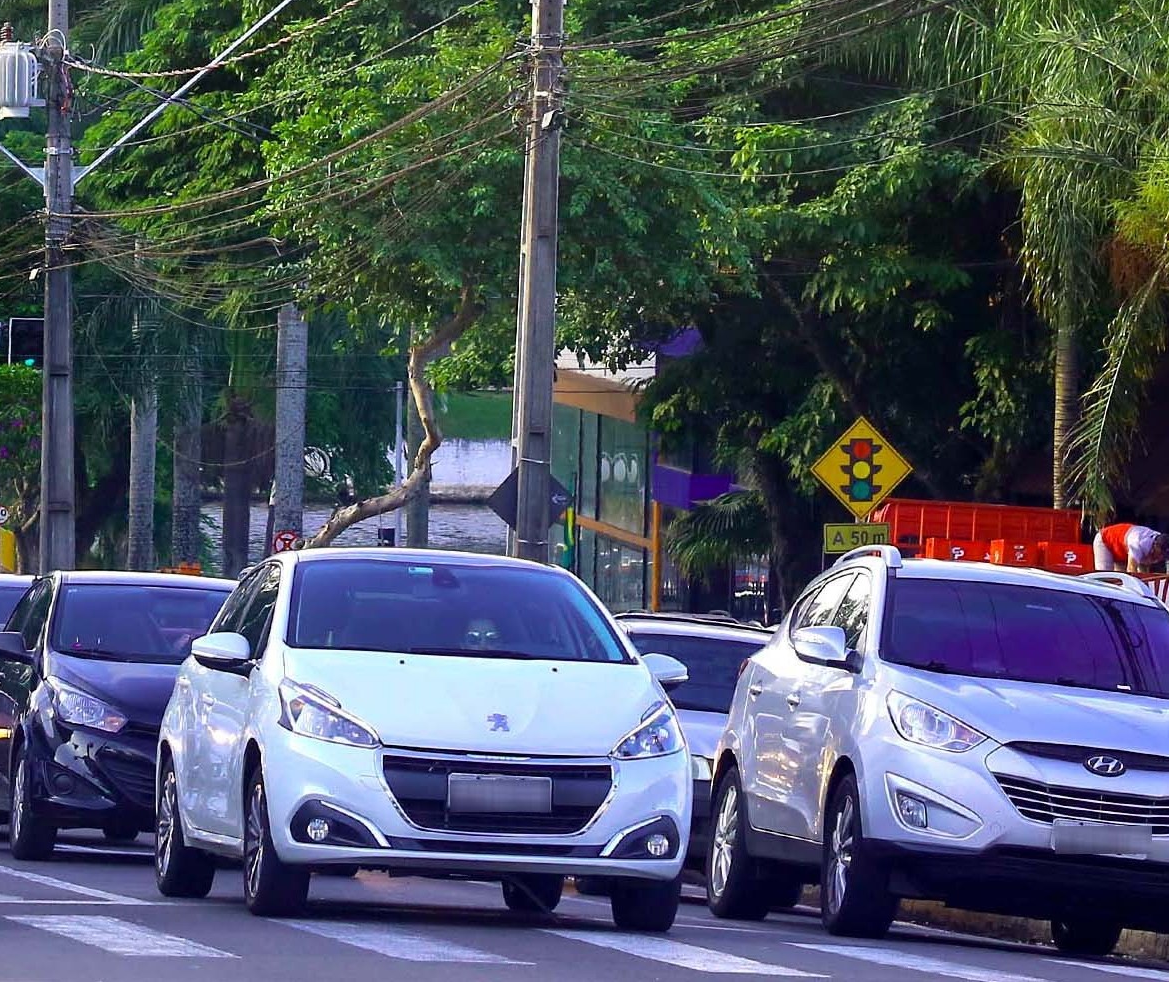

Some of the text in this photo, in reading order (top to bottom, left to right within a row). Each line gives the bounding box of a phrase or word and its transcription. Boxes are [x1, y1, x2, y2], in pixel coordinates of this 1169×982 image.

[833, 531, 885, 545] A 50 m
